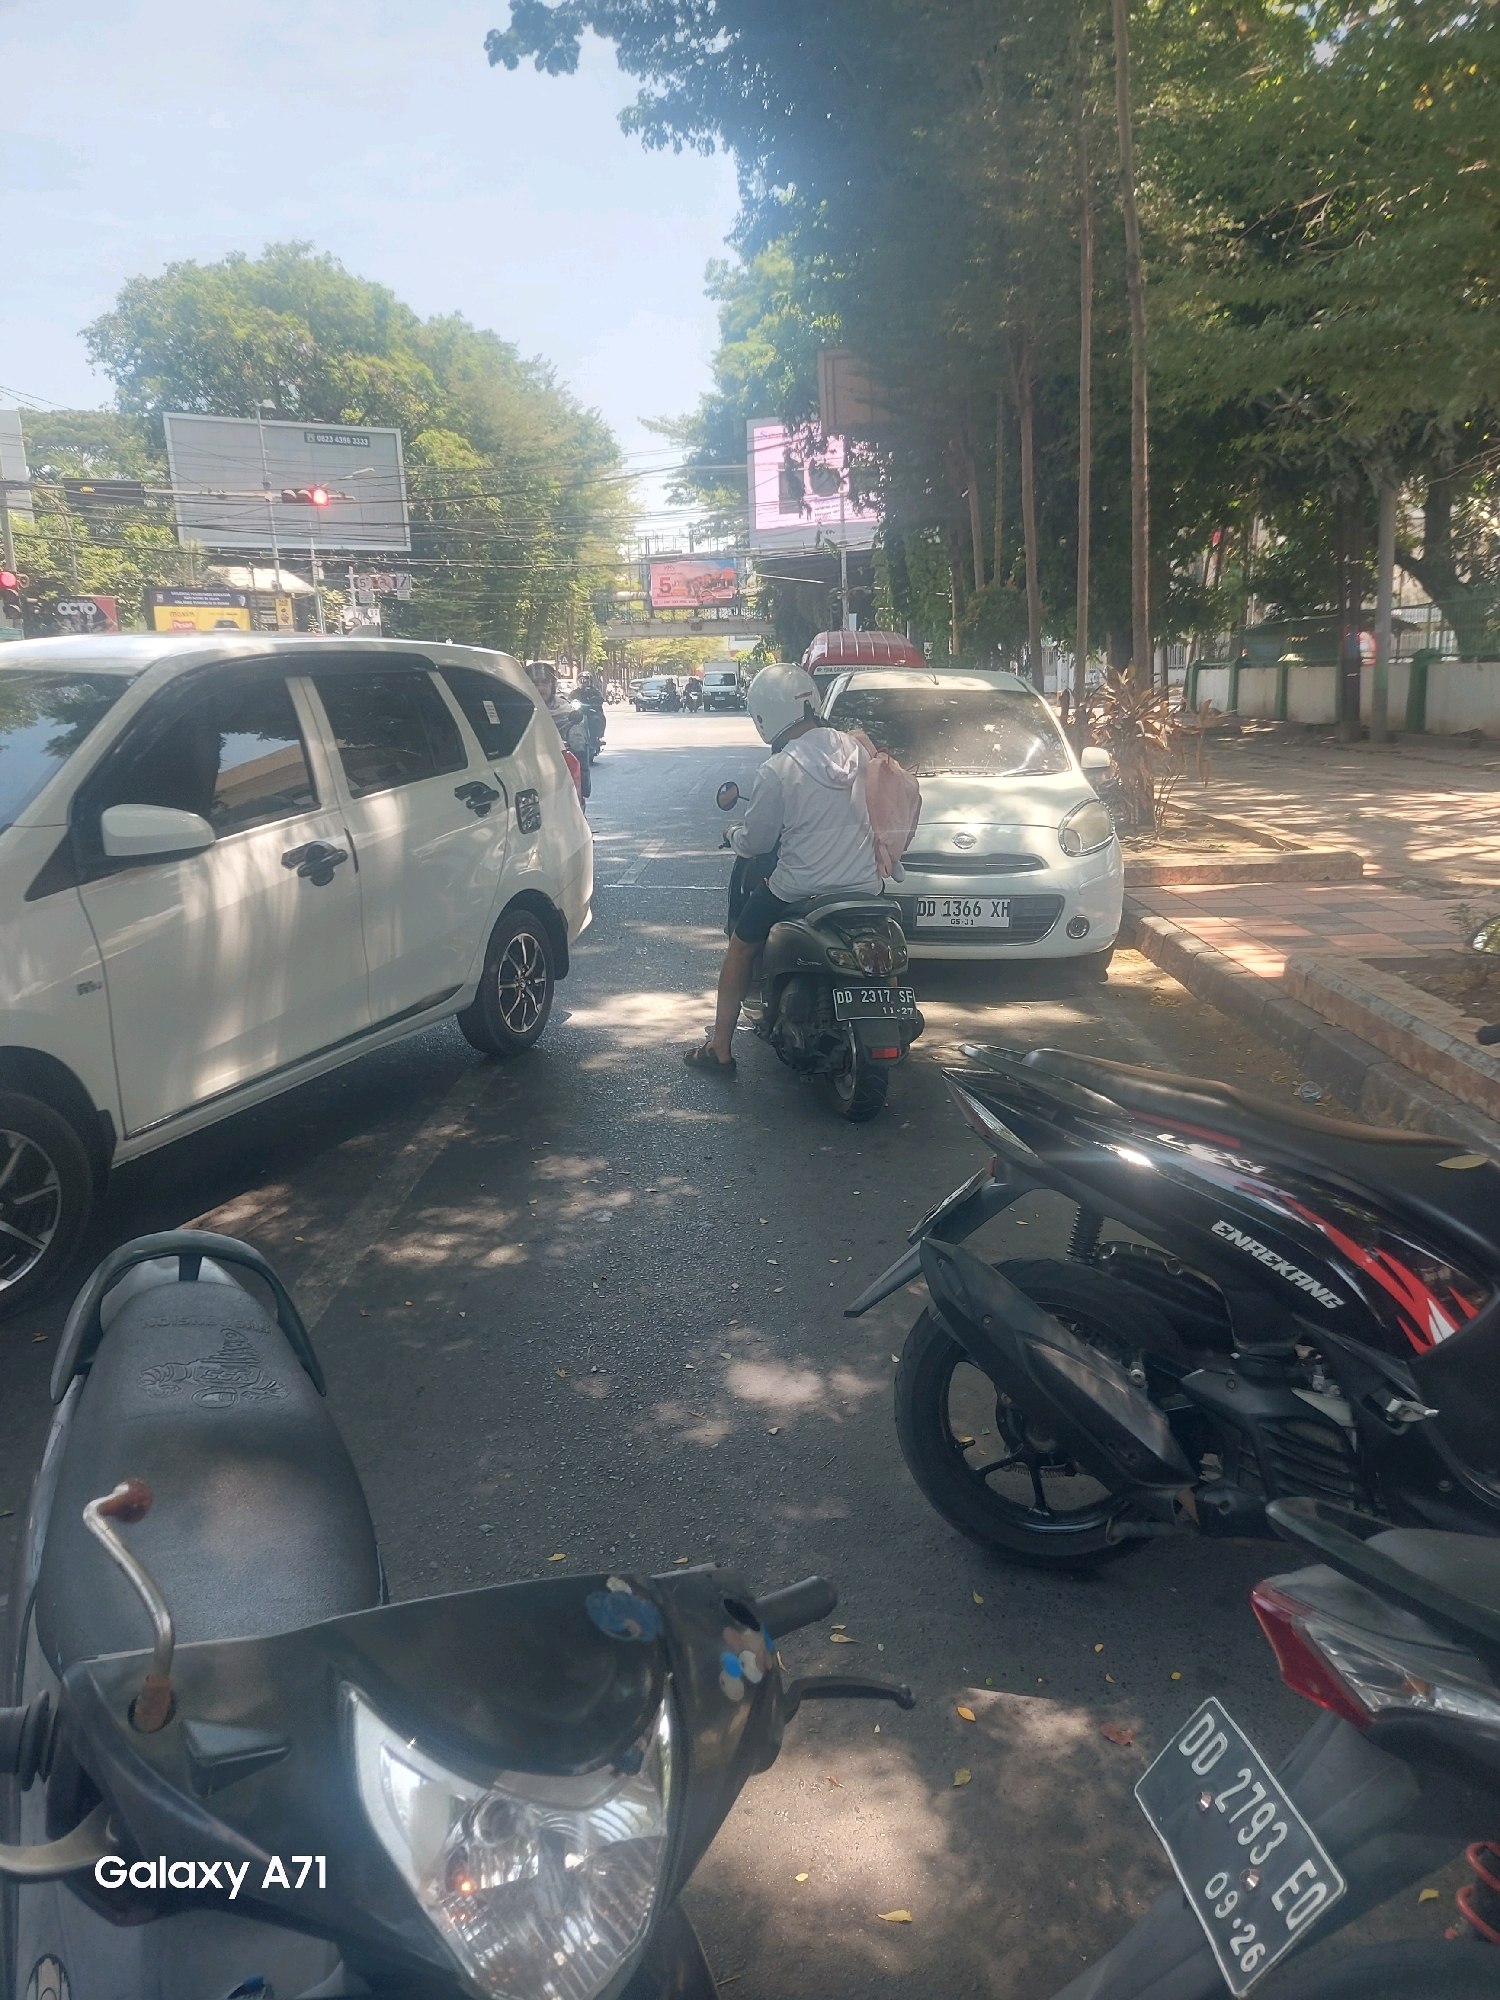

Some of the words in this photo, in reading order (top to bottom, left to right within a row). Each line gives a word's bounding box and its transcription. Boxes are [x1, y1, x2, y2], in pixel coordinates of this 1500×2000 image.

[57, 602, 97, 616] OCTO
[917, 900, 936, 917] DD
[943, 900, 981, 917] 1366
[991, 901, 1009, 918] XH
[836, 991, 853, 1004] DD
[861, 990, 890, 1002] 2317
[899, 990, 914, 1002] SF
[1211, 1219, 1346, 1309] ENREKANG
[1178, 1712, 1228, 1776] DD
[1214, 1768, 1288, 1866] 2793
